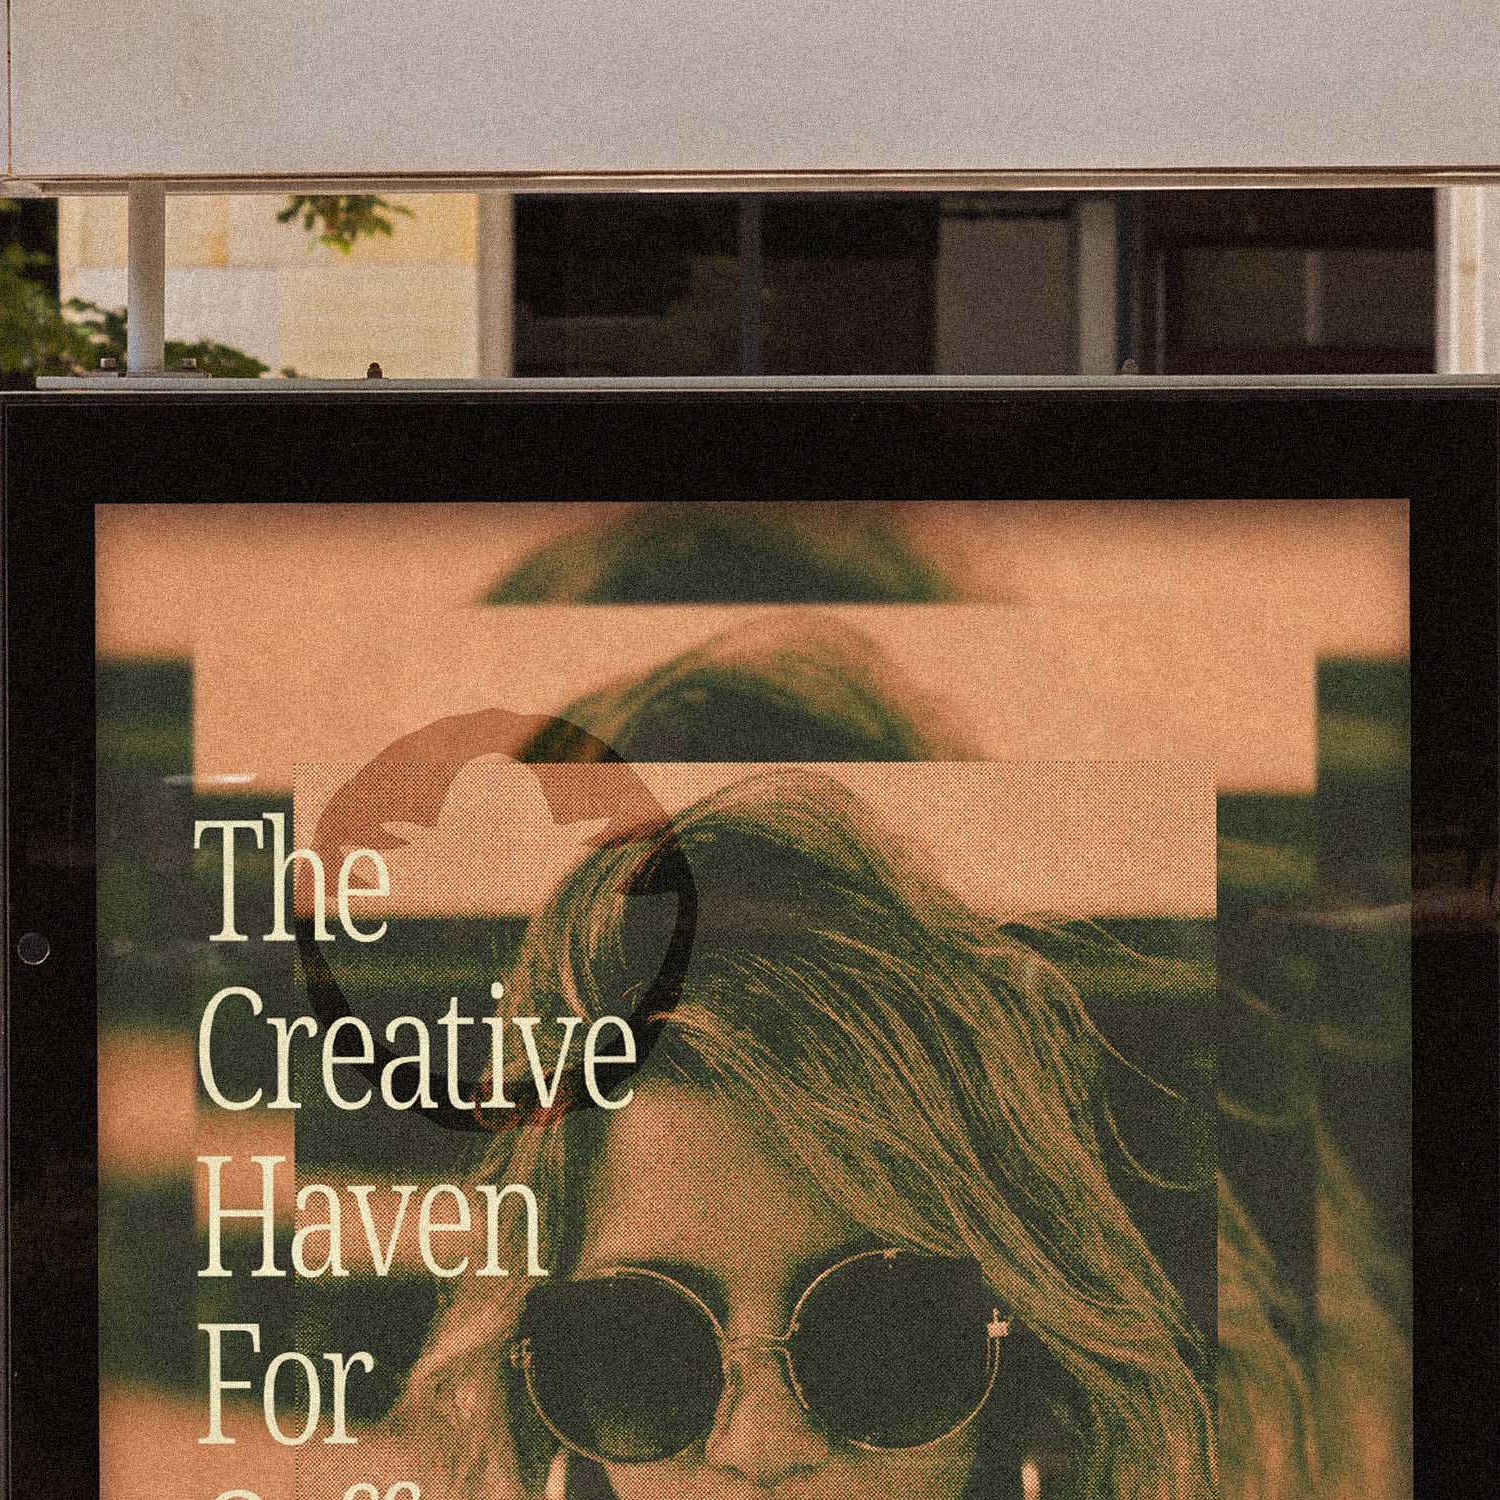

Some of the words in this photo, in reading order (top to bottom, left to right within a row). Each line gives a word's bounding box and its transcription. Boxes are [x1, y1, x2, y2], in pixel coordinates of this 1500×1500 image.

[195, 813, 391, 942] The
[200, 981, 635, 1110] Creative
[197, 1156, 545, 1277] Haven
[198, 1323, 375, 1445] For
